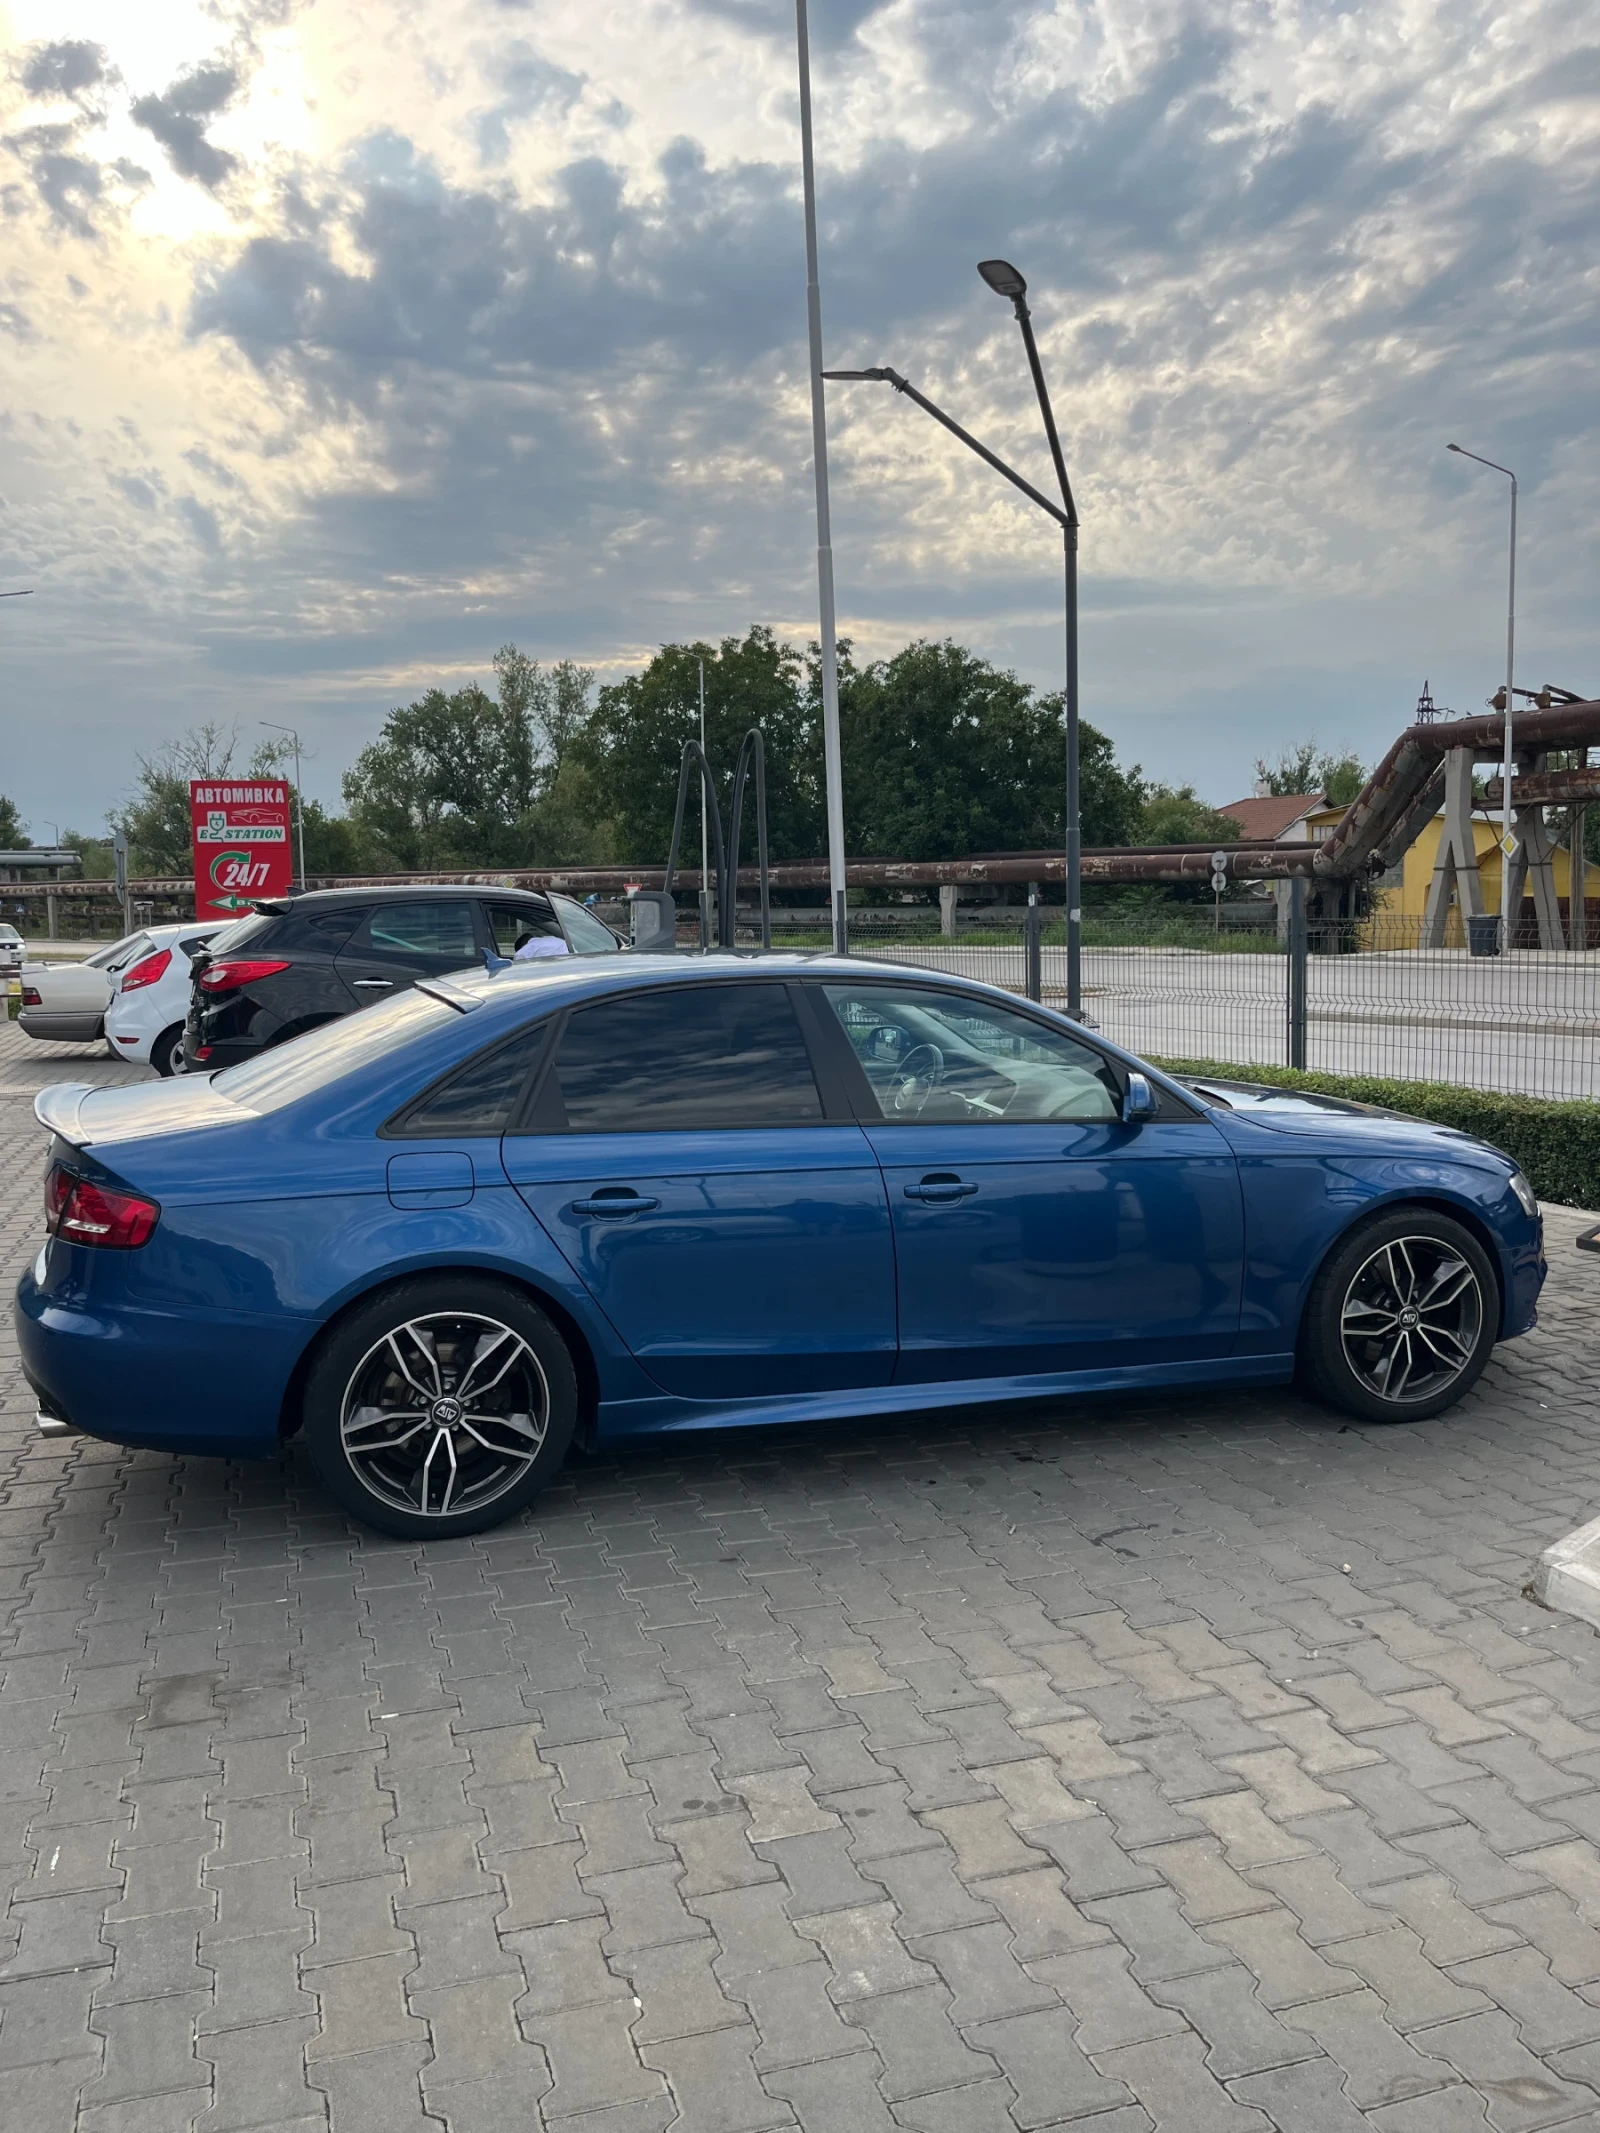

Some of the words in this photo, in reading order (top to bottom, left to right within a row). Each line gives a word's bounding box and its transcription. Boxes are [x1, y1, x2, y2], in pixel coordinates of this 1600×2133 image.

[195, 787, 285, 804] АВТОМИВКА
[199, 829, 209, 839] E
[224, 829, 283, 839] STATION
[223, 863, 270, 887] 24/7
